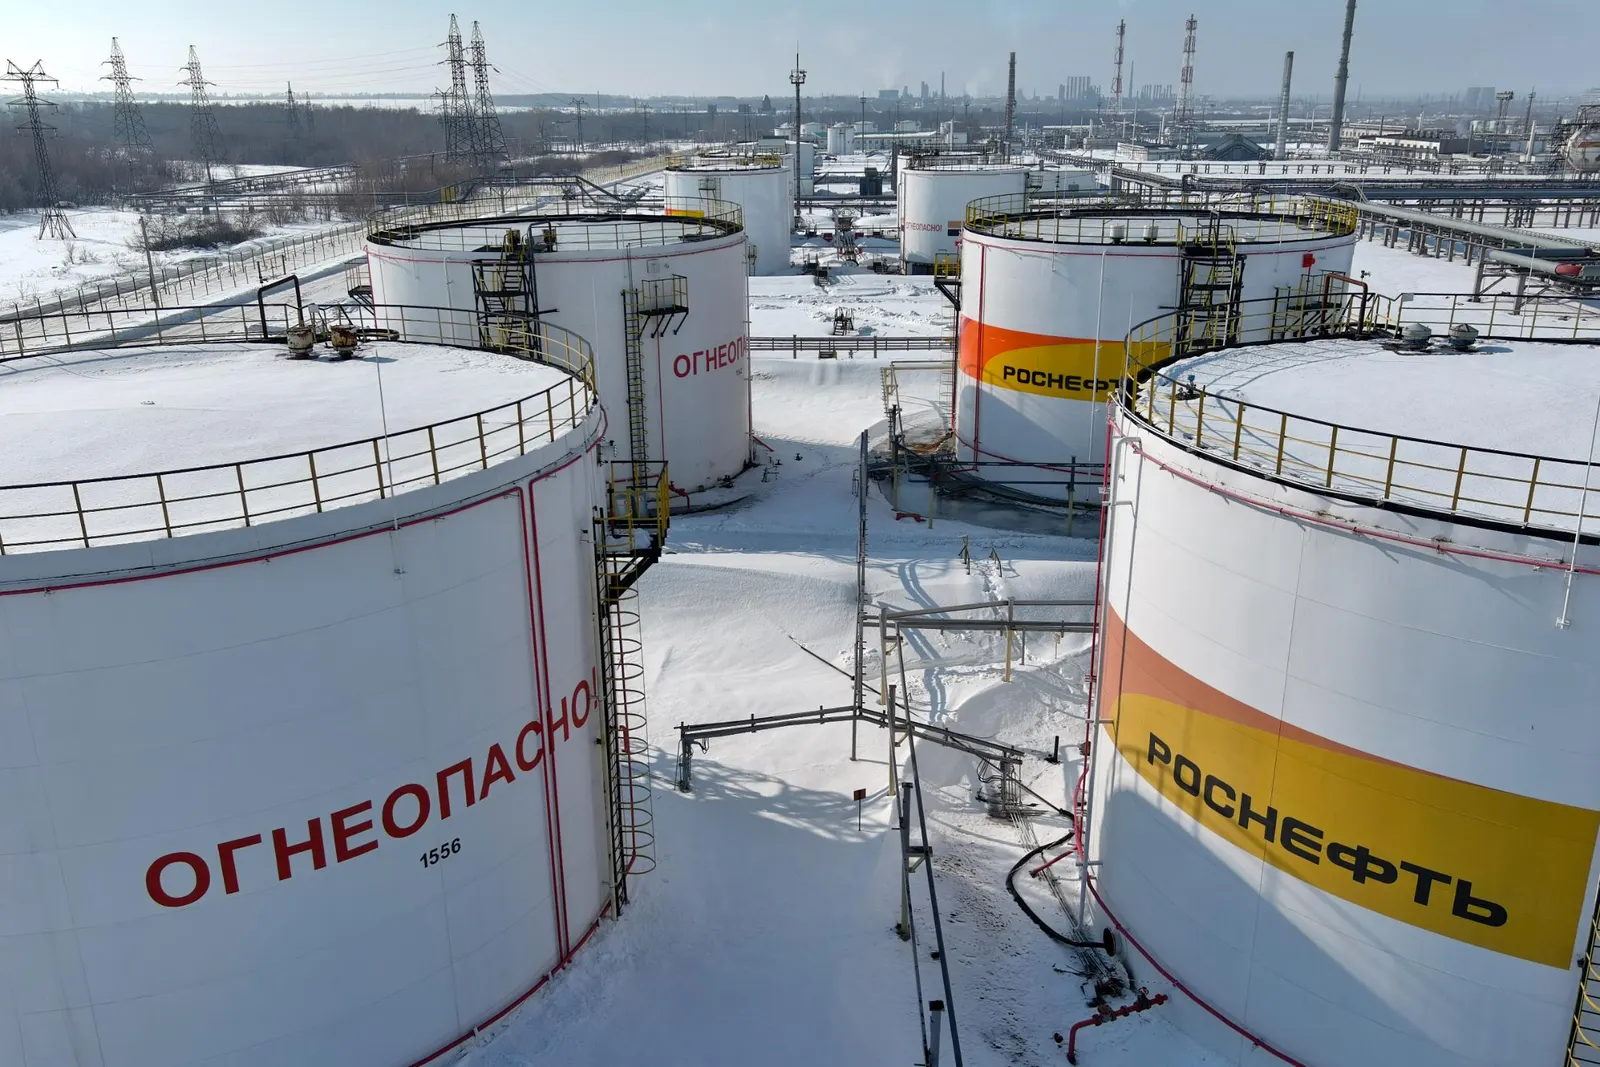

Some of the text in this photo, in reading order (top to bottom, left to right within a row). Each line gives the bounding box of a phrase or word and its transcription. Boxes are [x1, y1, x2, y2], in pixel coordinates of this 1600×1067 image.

[1003, 365, 1120, 392] РОСНЕФТ
[145, 666, 599, 908] ОГНЕОПАСНО!
[1147, 731, 1508, 928] РОСНЕФТЬ
[419, 837, 462, 869] 1556
